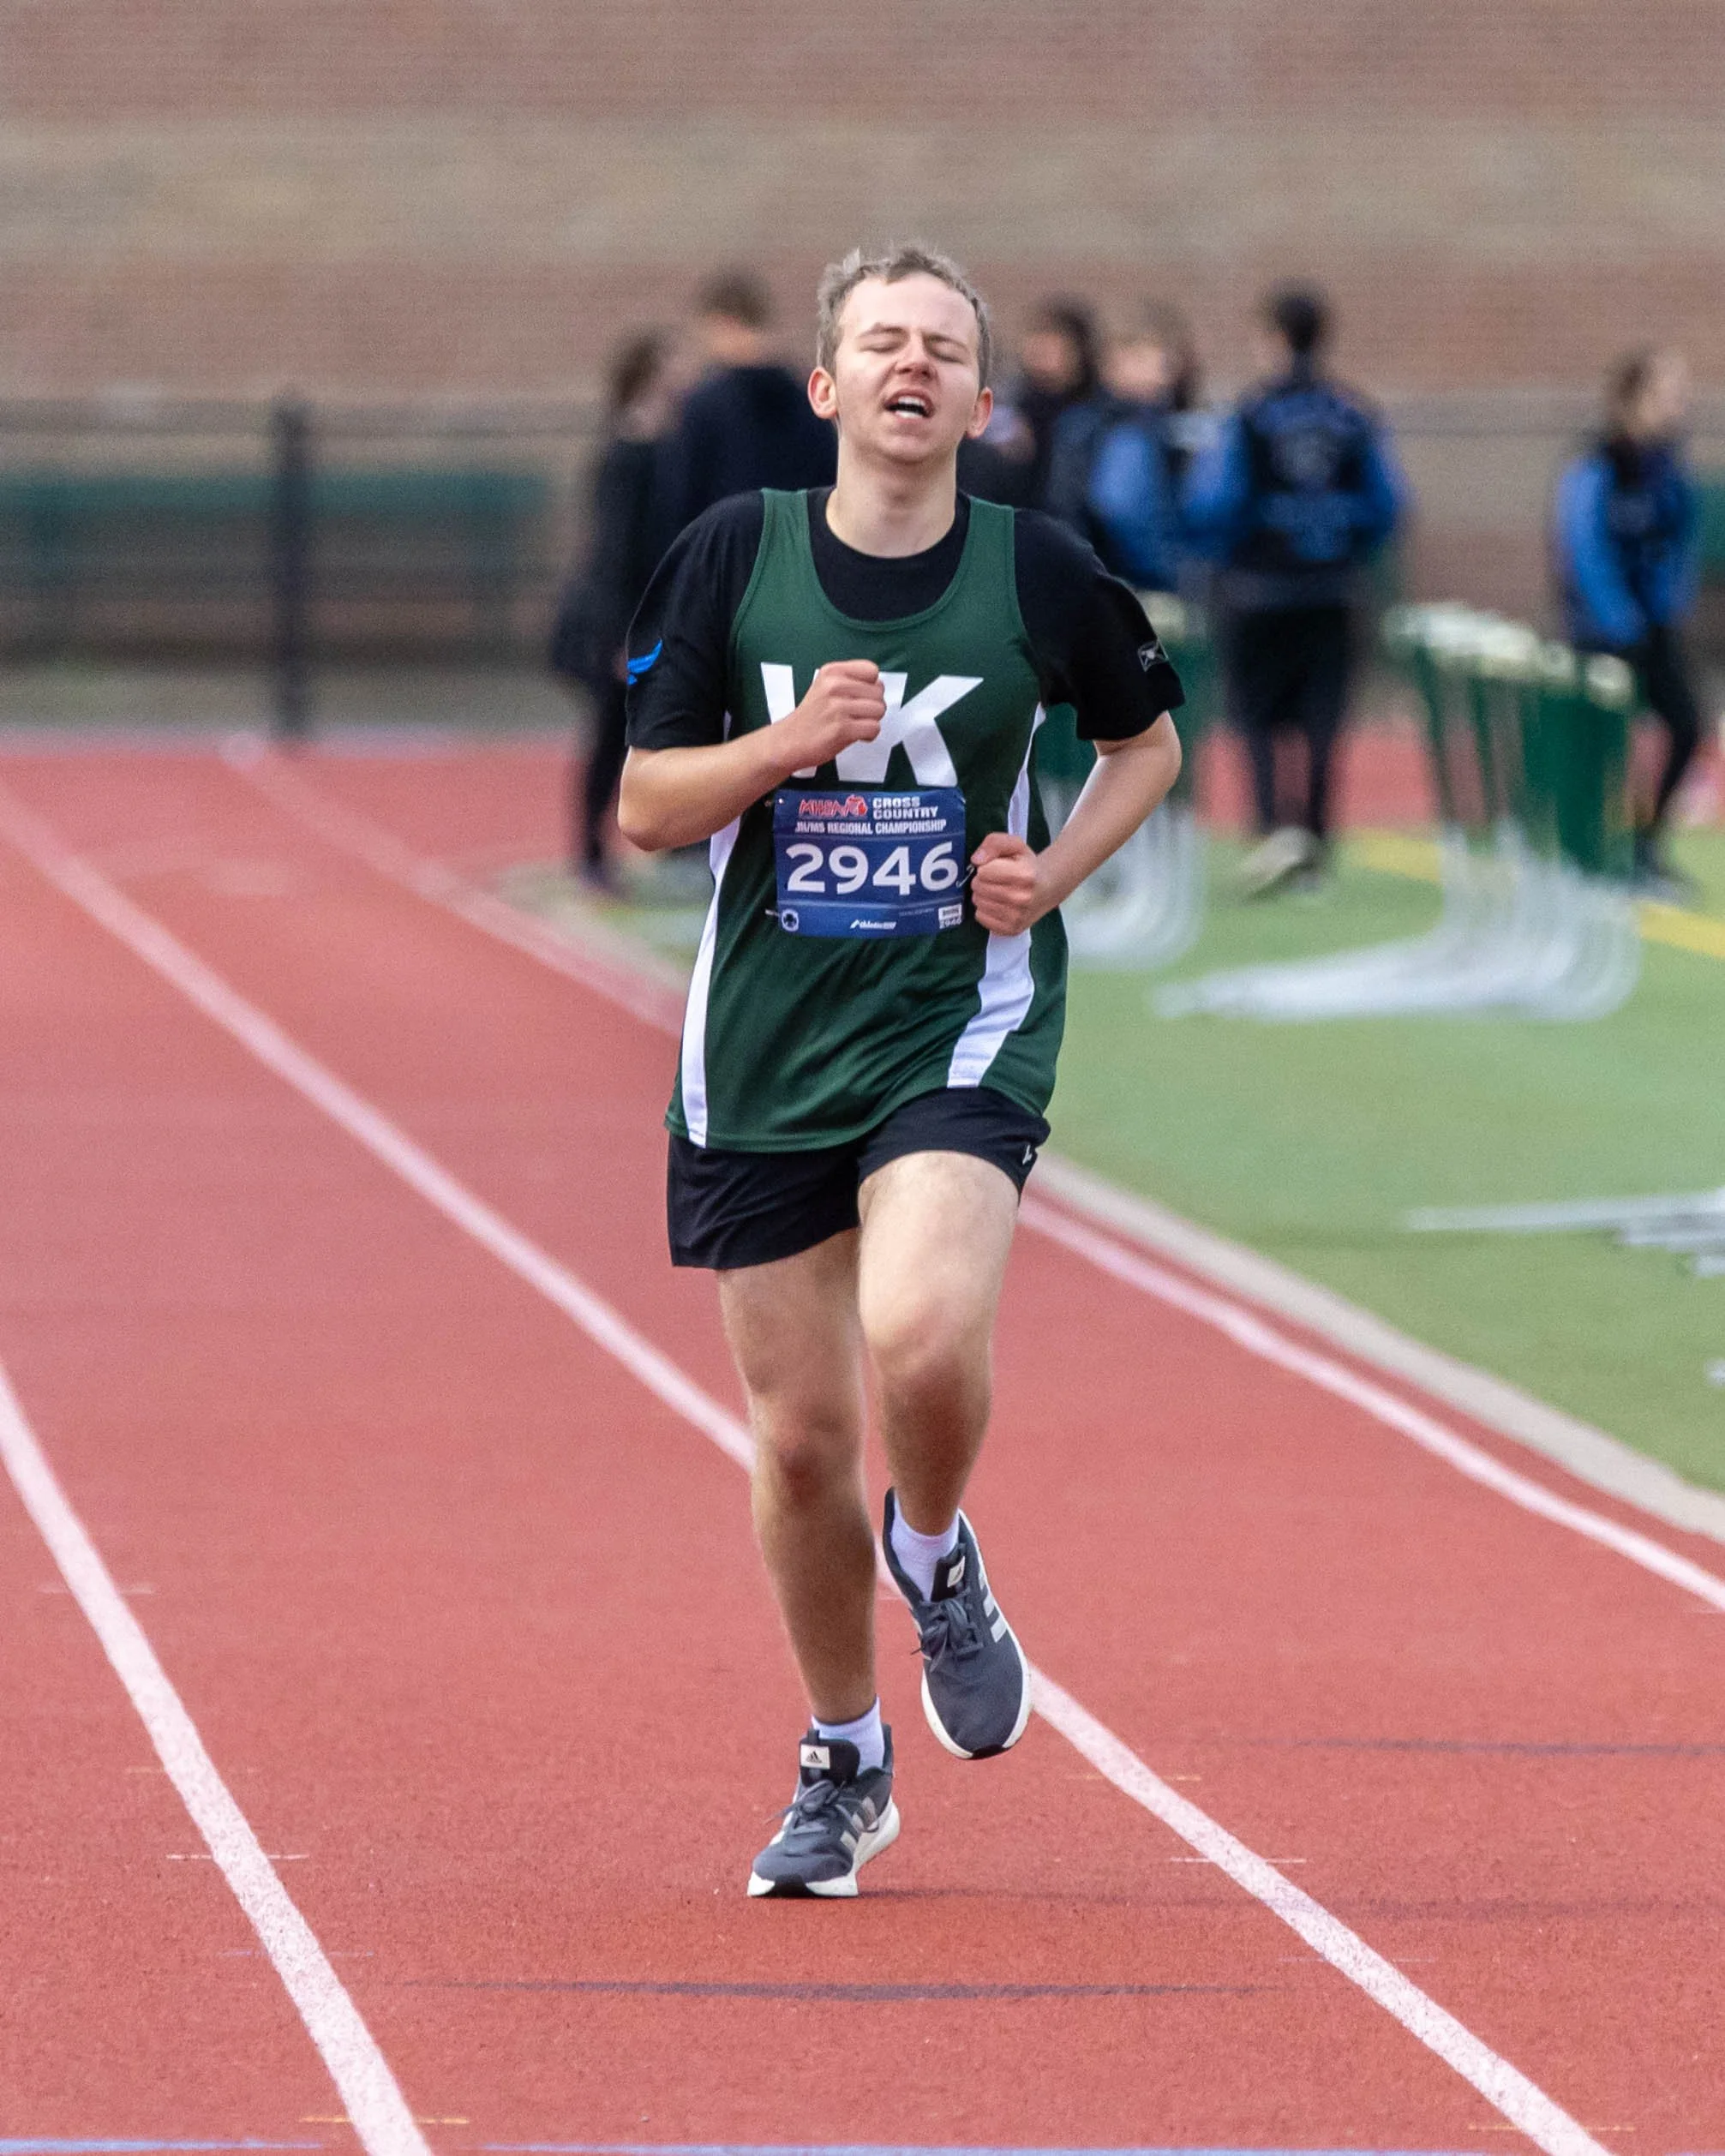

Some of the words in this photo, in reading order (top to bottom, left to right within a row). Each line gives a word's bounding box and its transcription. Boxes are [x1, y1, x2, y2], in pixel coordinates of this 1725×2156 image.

[872, 796, 920, 808] CROSS
[872, 806, 938, 820] COUNTRY
[827, 822, 873, 835] REGIONAL
[875, 818, 947, 835] CHAMPIONSHIP
[785, 841, 959, 895] 2946
